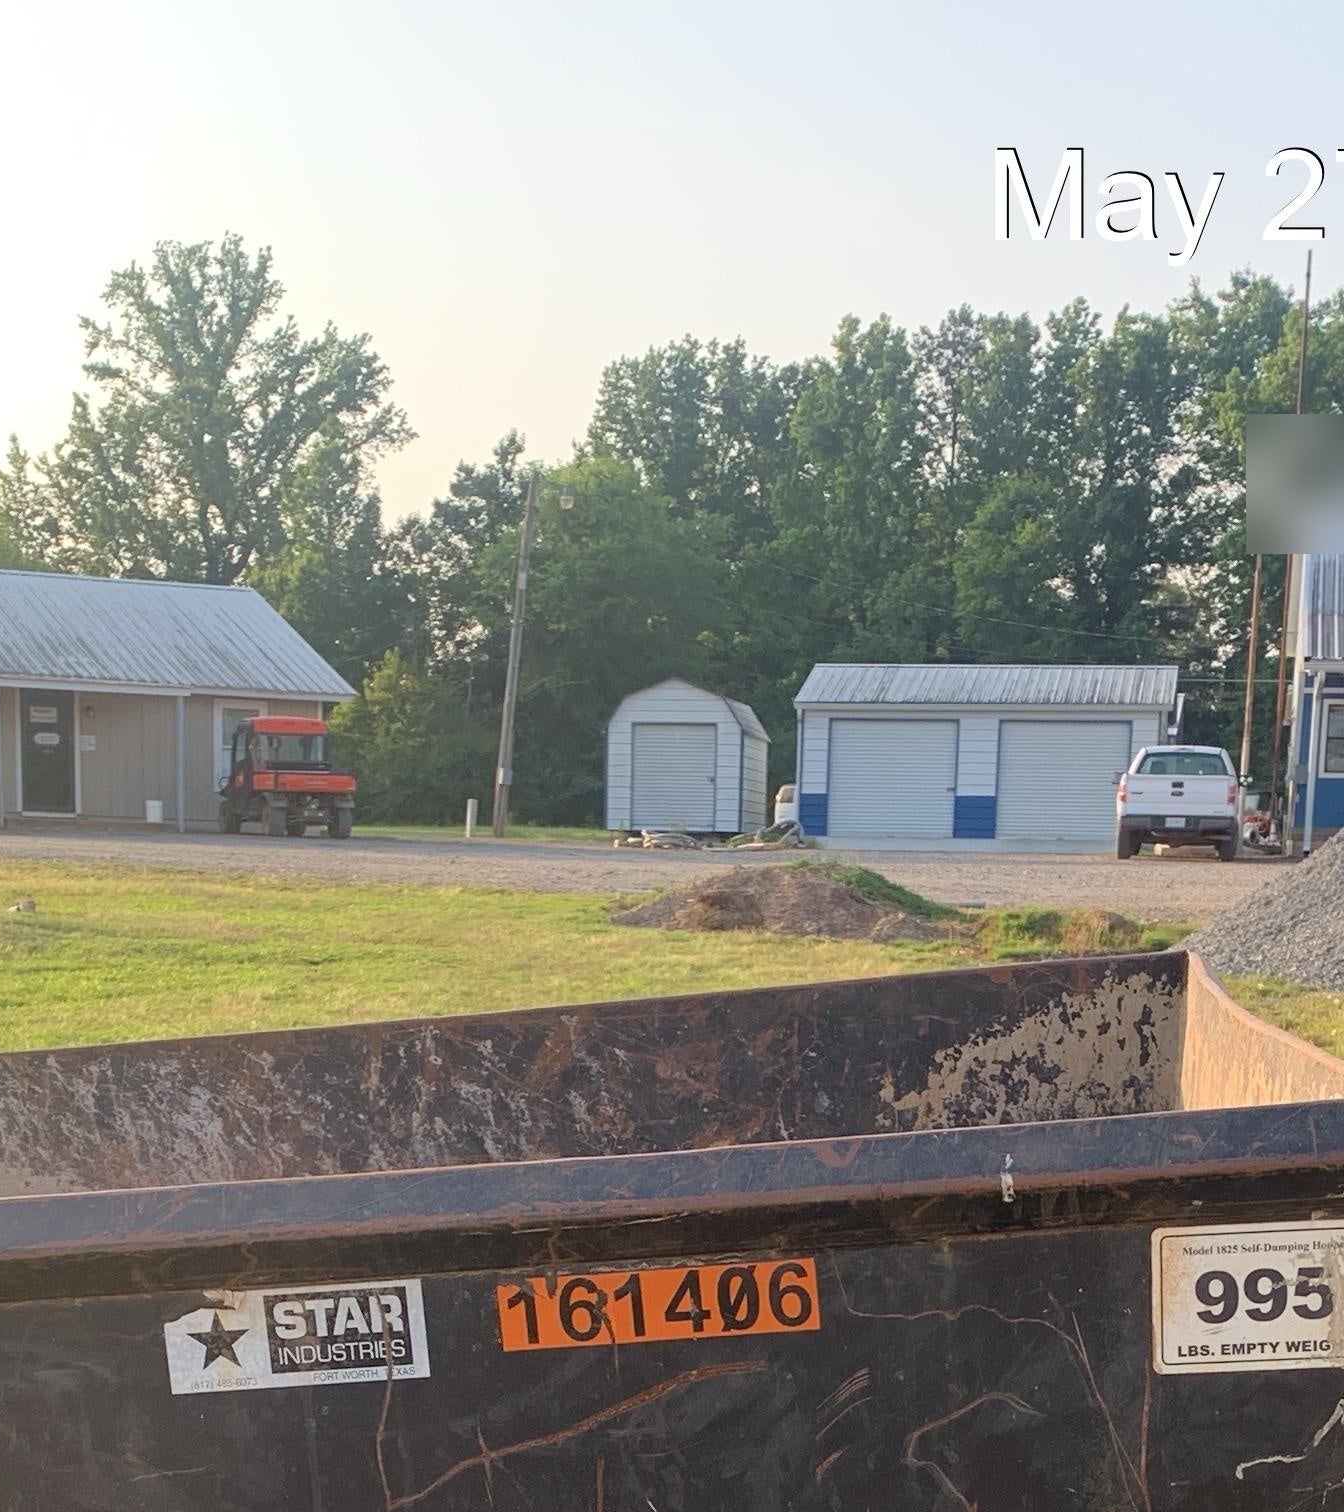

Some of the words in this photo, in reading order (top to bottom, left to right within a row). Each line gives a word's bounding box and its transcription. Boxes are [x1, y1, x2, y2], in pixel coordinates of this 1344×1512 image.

[1183, 1245, 1213, 1256] Model
[1217, 1244, 1238, 1255] 1825
[1241, 1242, 1310, 1255] Self-Dumping
[507, 1262, 812, 1345] 161406
[1195, 1266, 1334, 1324] 995
[272, 1294, 404, 1340] STAR
[278, 1339, 406, 1365] INDUSTRIES
[1178, 1345, 1216, 1358] LBS.
[1221, 1341, 1280, 1355] EMPTY
[313, 1371, 339, 1382] FORT
